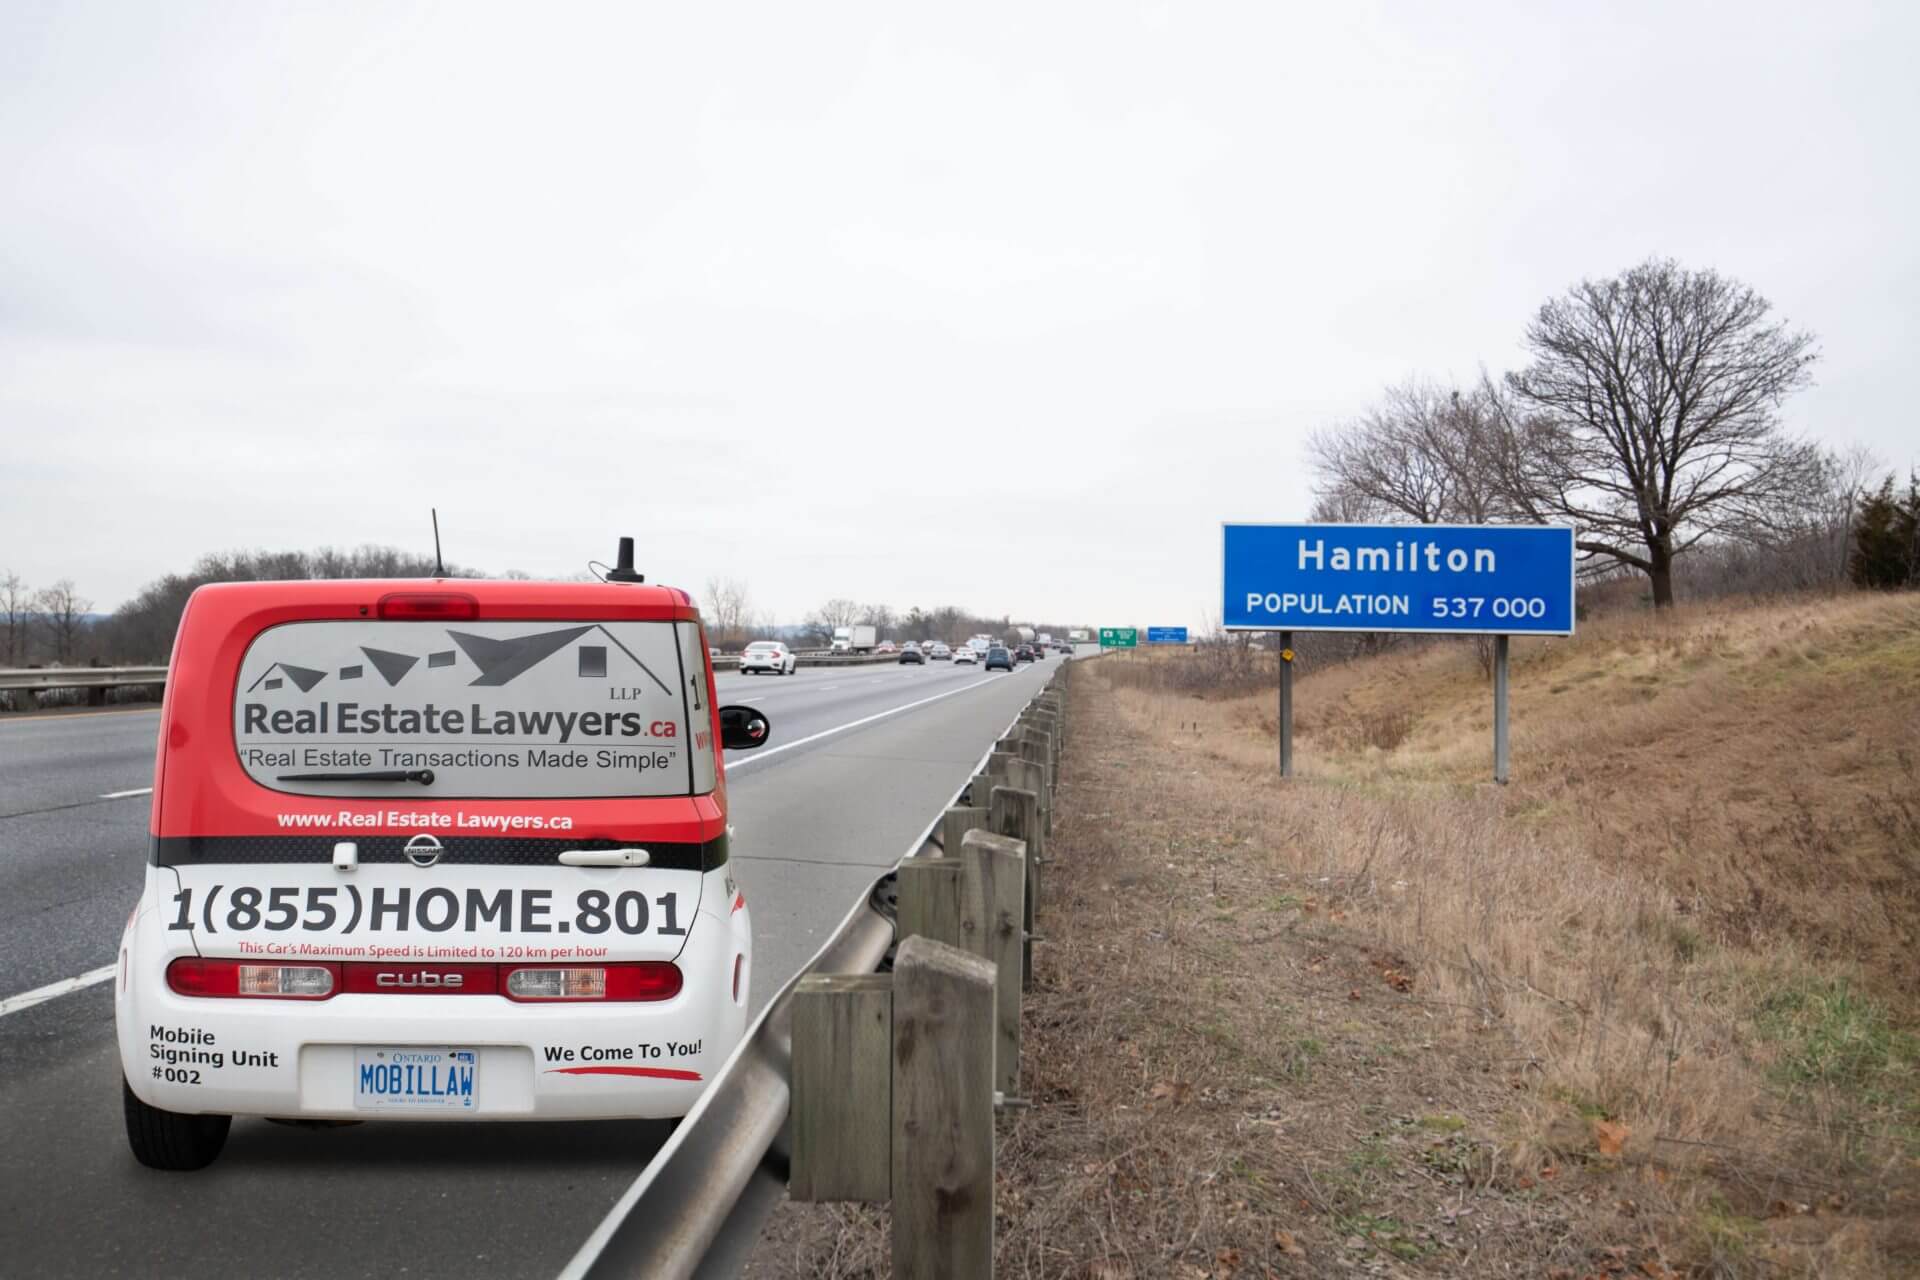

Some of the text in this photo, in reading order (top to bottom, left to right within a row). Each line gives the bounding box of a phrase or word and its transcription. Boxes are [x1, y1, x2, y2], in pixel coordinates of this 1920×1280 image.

[1298, 540, 1496, 572] Hamilton
[1247, 593, 1546, 618] POPULATION 537 000
[610, 687, 642, 700] LLP
[240, 749, 676, 773] “Real Estate Transactions Made Simple”
[457, 812, 573, 832] Lawyers.ca
[168, 884, 687, 936] 1(855)HOME.801
[239, 942, 608, 960] This Car’s Maximum Speed is Limited to 120 km per hour
[376, 970, 464, 987] cube
[150, 1025, 215, 1045] Mobile
[150, 1043, 279, 1068] Signing Unit
[544, 1039, 702, 1061] We Come To You!
[152, 1066, 202, 1085] #002
[360, 1064, 473, 1096] MOBILLAW
